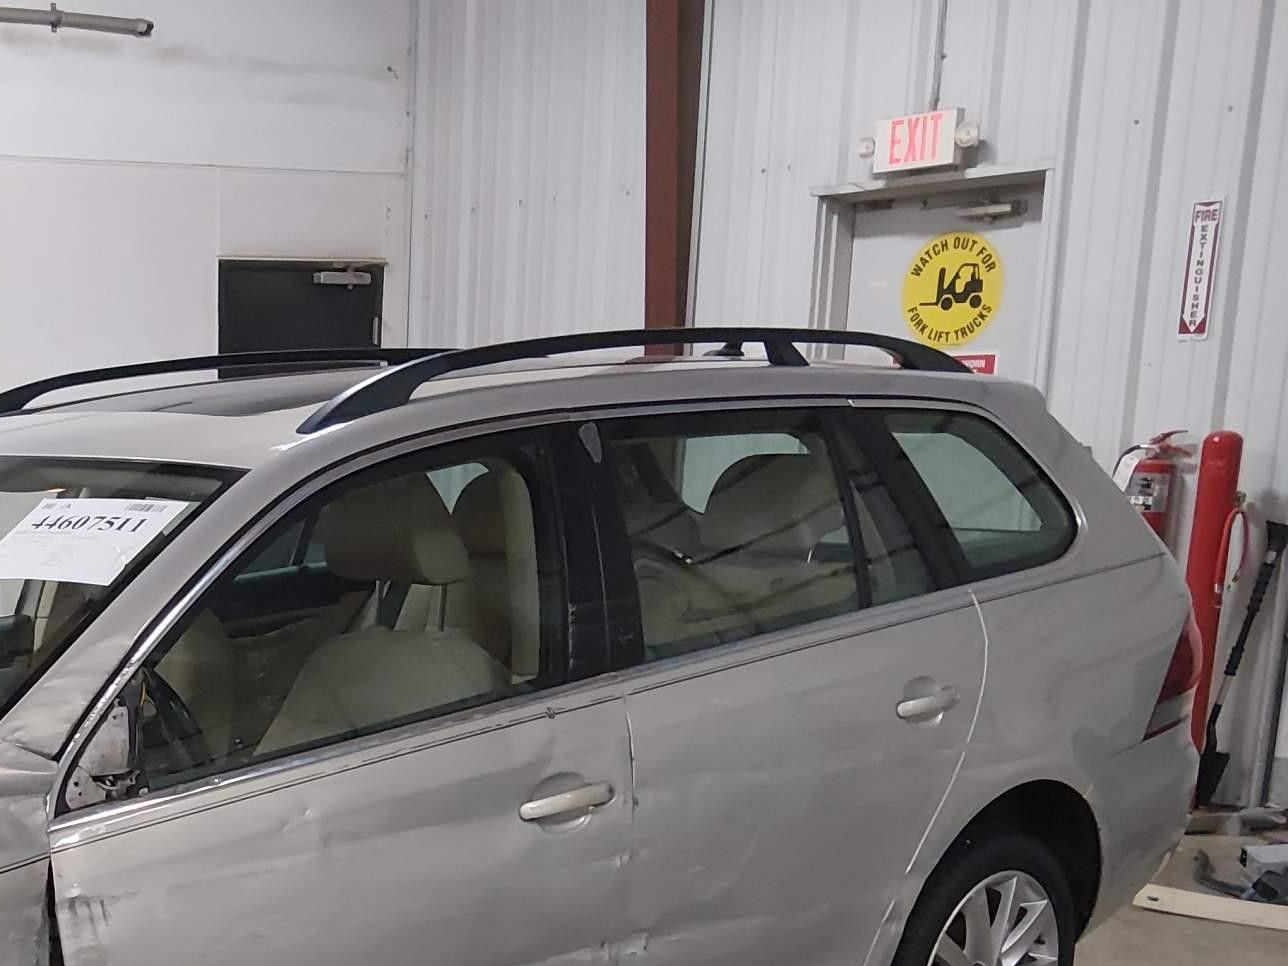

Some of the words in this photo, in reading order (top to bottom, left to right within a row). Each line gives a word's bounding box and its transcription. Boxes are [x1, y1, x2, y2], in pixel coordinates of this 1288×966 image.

[889, 113, 943, 164] EXIT
[1194, 209, 1219, 222] FIRE
[911, 239, 949, 277] WATCH
[953, 236, 978, 253] OUT
[976, 246, 996, 273] FOR
[1189, 224, 1209, 327] EXTINGUISHER
[907, 306, 929, 336] FORK
[928, 328, 951, 343] LIFT
[954, 303, 992, 342] TRUCKS
[32, 514, 148, 533] 44607511
